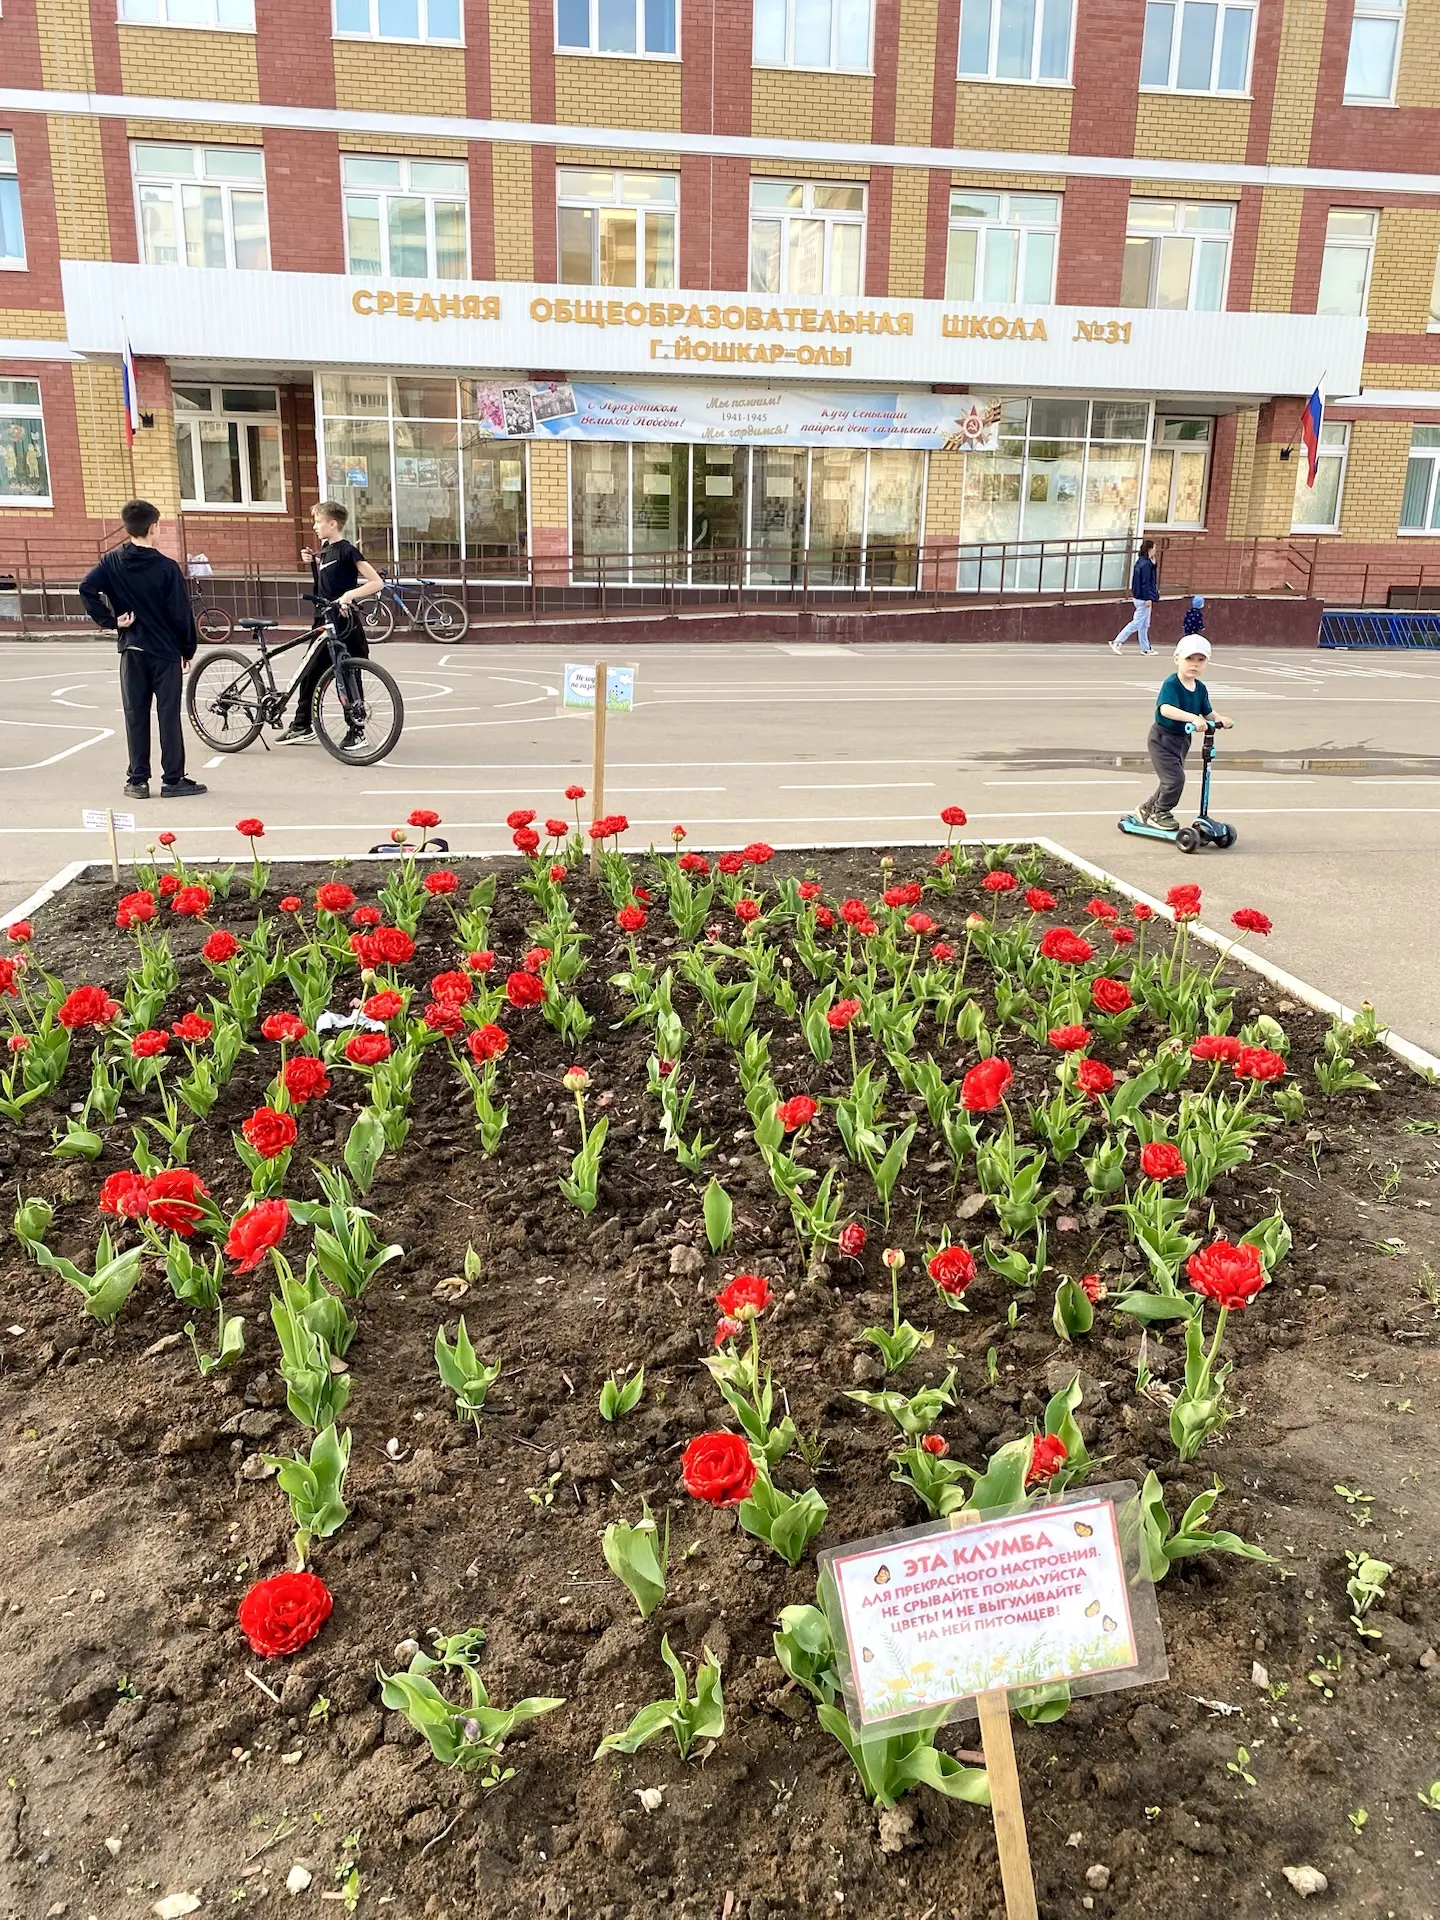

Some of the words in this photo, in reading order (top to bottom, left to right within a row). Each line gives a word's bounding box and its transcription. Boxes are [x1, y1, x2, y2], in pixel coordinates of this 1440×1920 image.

[352, 289, 501, 321] СРЕДНЯЯ
[529, 297, 914, 336] ОБЩЕОБРАЗОВАТЕЛЬНАЯ
[941, 314, 1048, 341] ШКОЛА
[1072, 319, 1132, 344] №31
[599, 398, 678, 415] Праздником
[705, 397, 730, 409] Мы
[731, 394, 782, 408] помним!
[580, 414, 630, 426] Великой
[632, 414, 686, 428] Победы!
[721, 412, 768, 422] 1941-1945
[820, 407, 850, 421] Кугу
[701, 427, 726, 439] Мы
[727, 423, 789, 440] гордимся!
[800, 422, 845, 435] пайрем
[847, 421, 871, 433] дене
[903, 1553, 948, 1577] ЭТА
[952, 1531, 1054, 1567] КЛУМБА
[861, 1590, 892, 1609] ДЛЯ
[894, 1566, 998, 1600] ПРЕКРАСНОГО
[1001, 1546, 1102, 1576] НАСТРОЕНИЯ.
[881, 1605, 901, 1619] НЕ
[903, 1587, 980, 1613] СРЫВАЙТЕ
[982, 1567, 1088, 1597] ПОЖАЛУЙСТА
[890, 1611, 940, 1634] ЦВЕТЫ
[942, 1607, 954, 1620] И
[956, 1604, 976, 1618] НЕ
[978, 1584, 1083, 1614] ВЫГУЛИВАЙТЕ
[917, 1628, 940, 1643] НА
[941, 1619, 971, 1637] НЕЙ
[973, 1604, 1061, 1631] ПИТОМЦЕВ!
